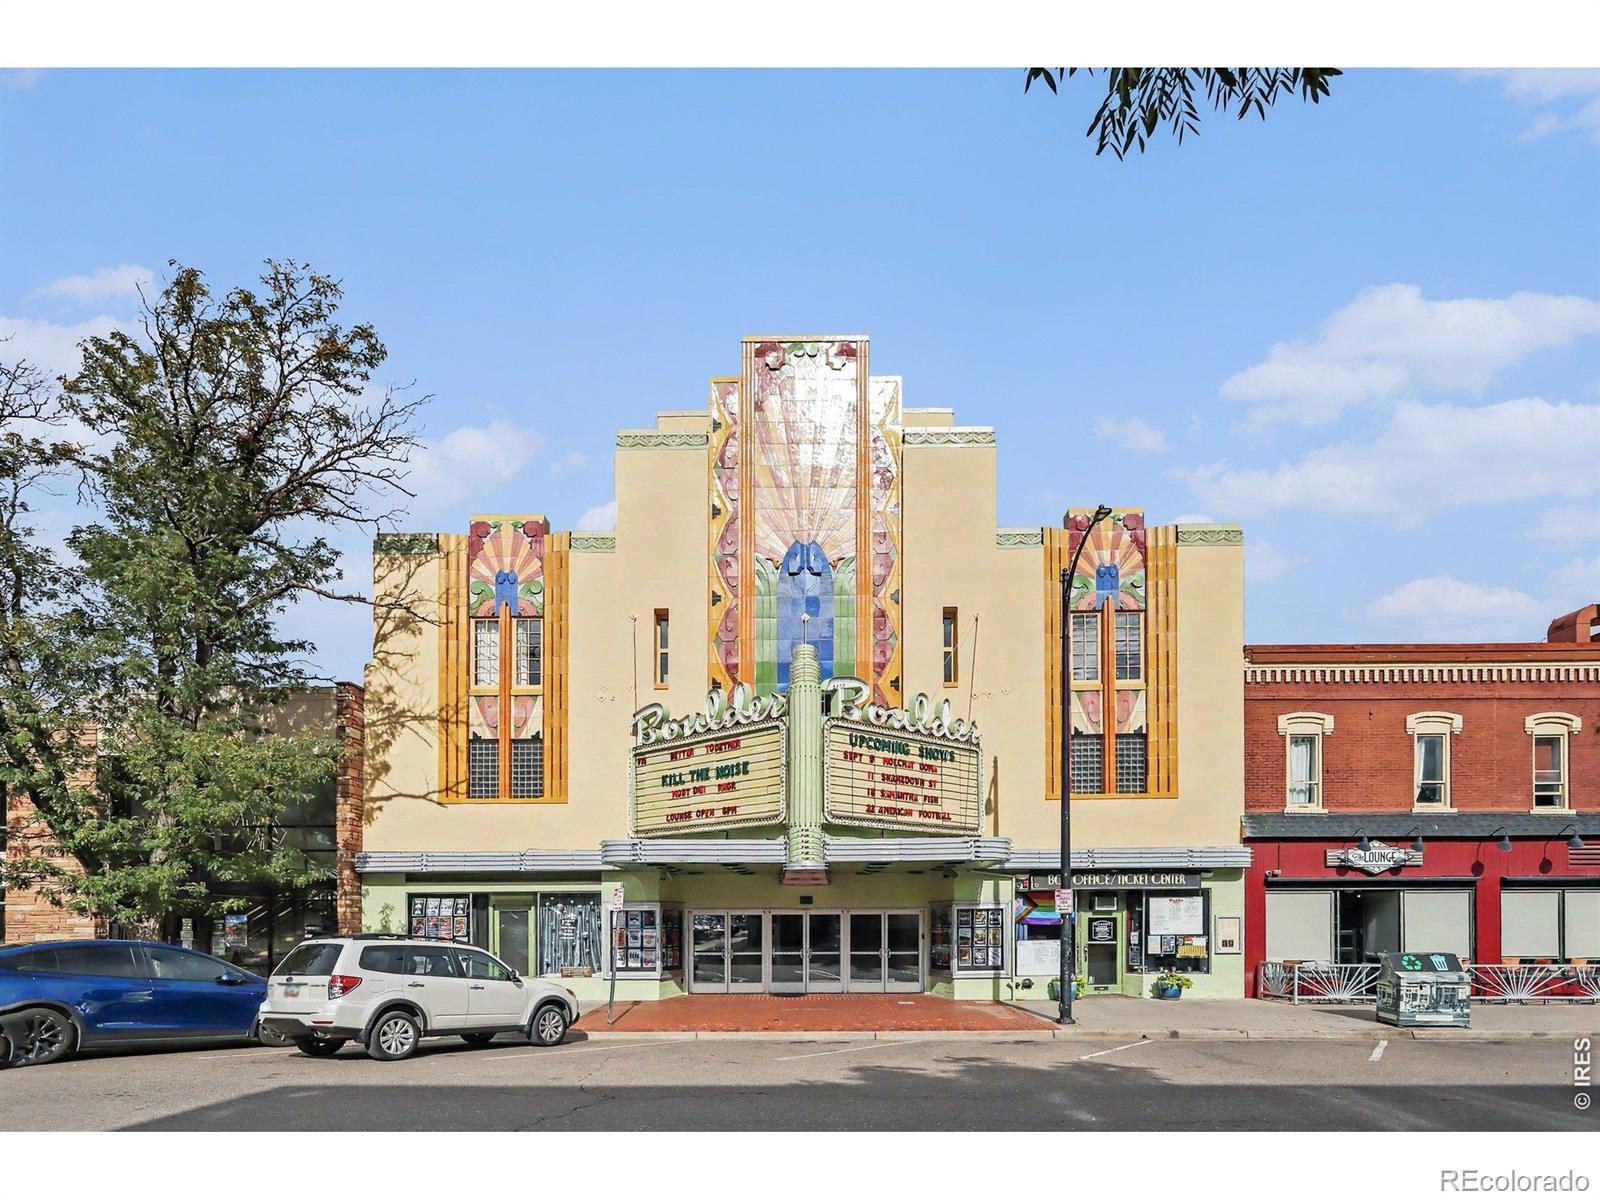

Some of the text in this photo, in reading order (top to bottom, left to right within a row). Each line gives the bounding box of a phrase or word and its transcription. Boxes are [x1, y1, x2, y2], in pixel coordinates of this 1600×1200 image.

[633, 682, 787, 745] Boulder
[826, 676, 981, 745] Boulder
[849, 732, 956, 763] UPCOMING SHOWS
[843, 750, 863, 762] SEPT
[661, 761, 751, 788] KILL THE NOISE
[665, 809, 693, 822] LOUNGE
[878, 805, 913, 817] AMERICAN
[918, 809, 952, 821] FOOTBALL
[1364, 851, 1397, 863] LOUNGE
[1151, 873, 1186, 885] CENTER
